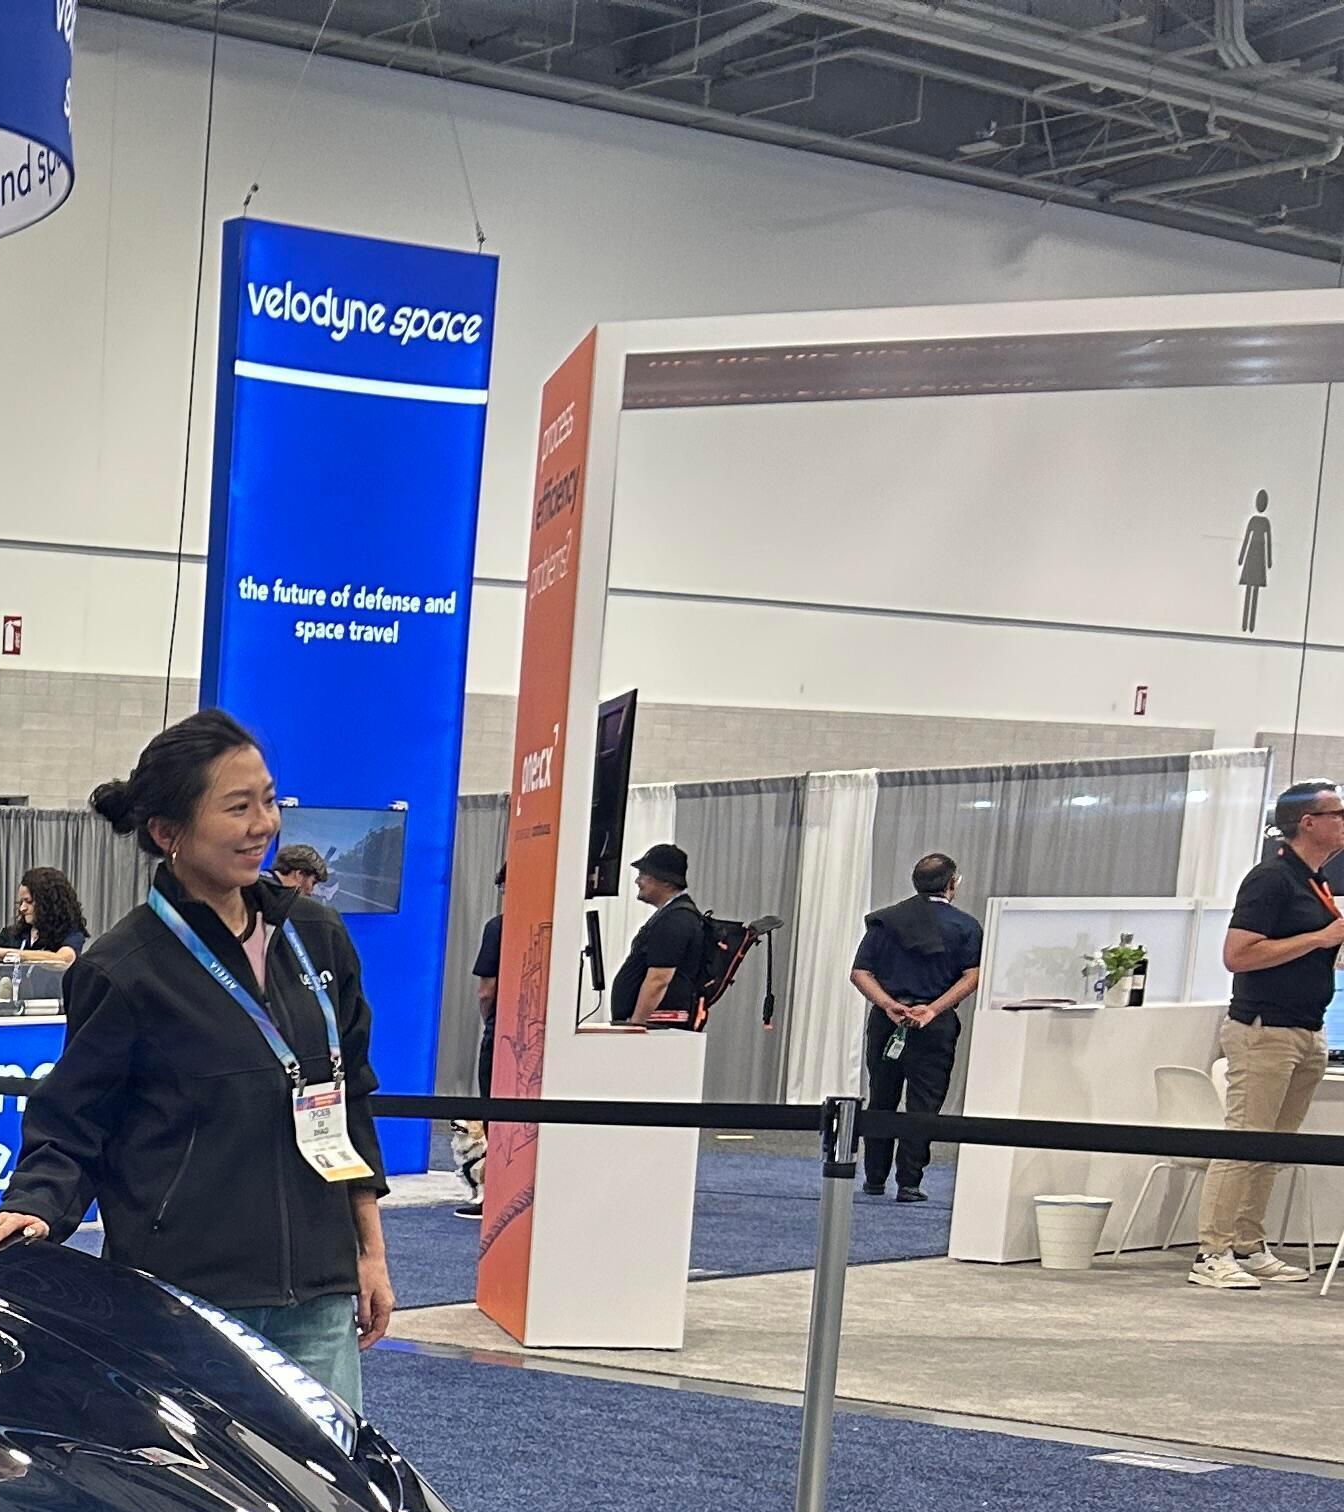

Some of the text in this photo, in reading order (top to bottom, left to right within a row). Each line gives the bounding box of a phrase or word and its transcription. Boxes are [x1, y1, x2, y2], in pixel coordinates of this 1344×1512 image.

[247, 280, 483, 346] velodyne space
[238, 576, 457, 614] the future of defense and
[294, 620, 399, 644] space travel
